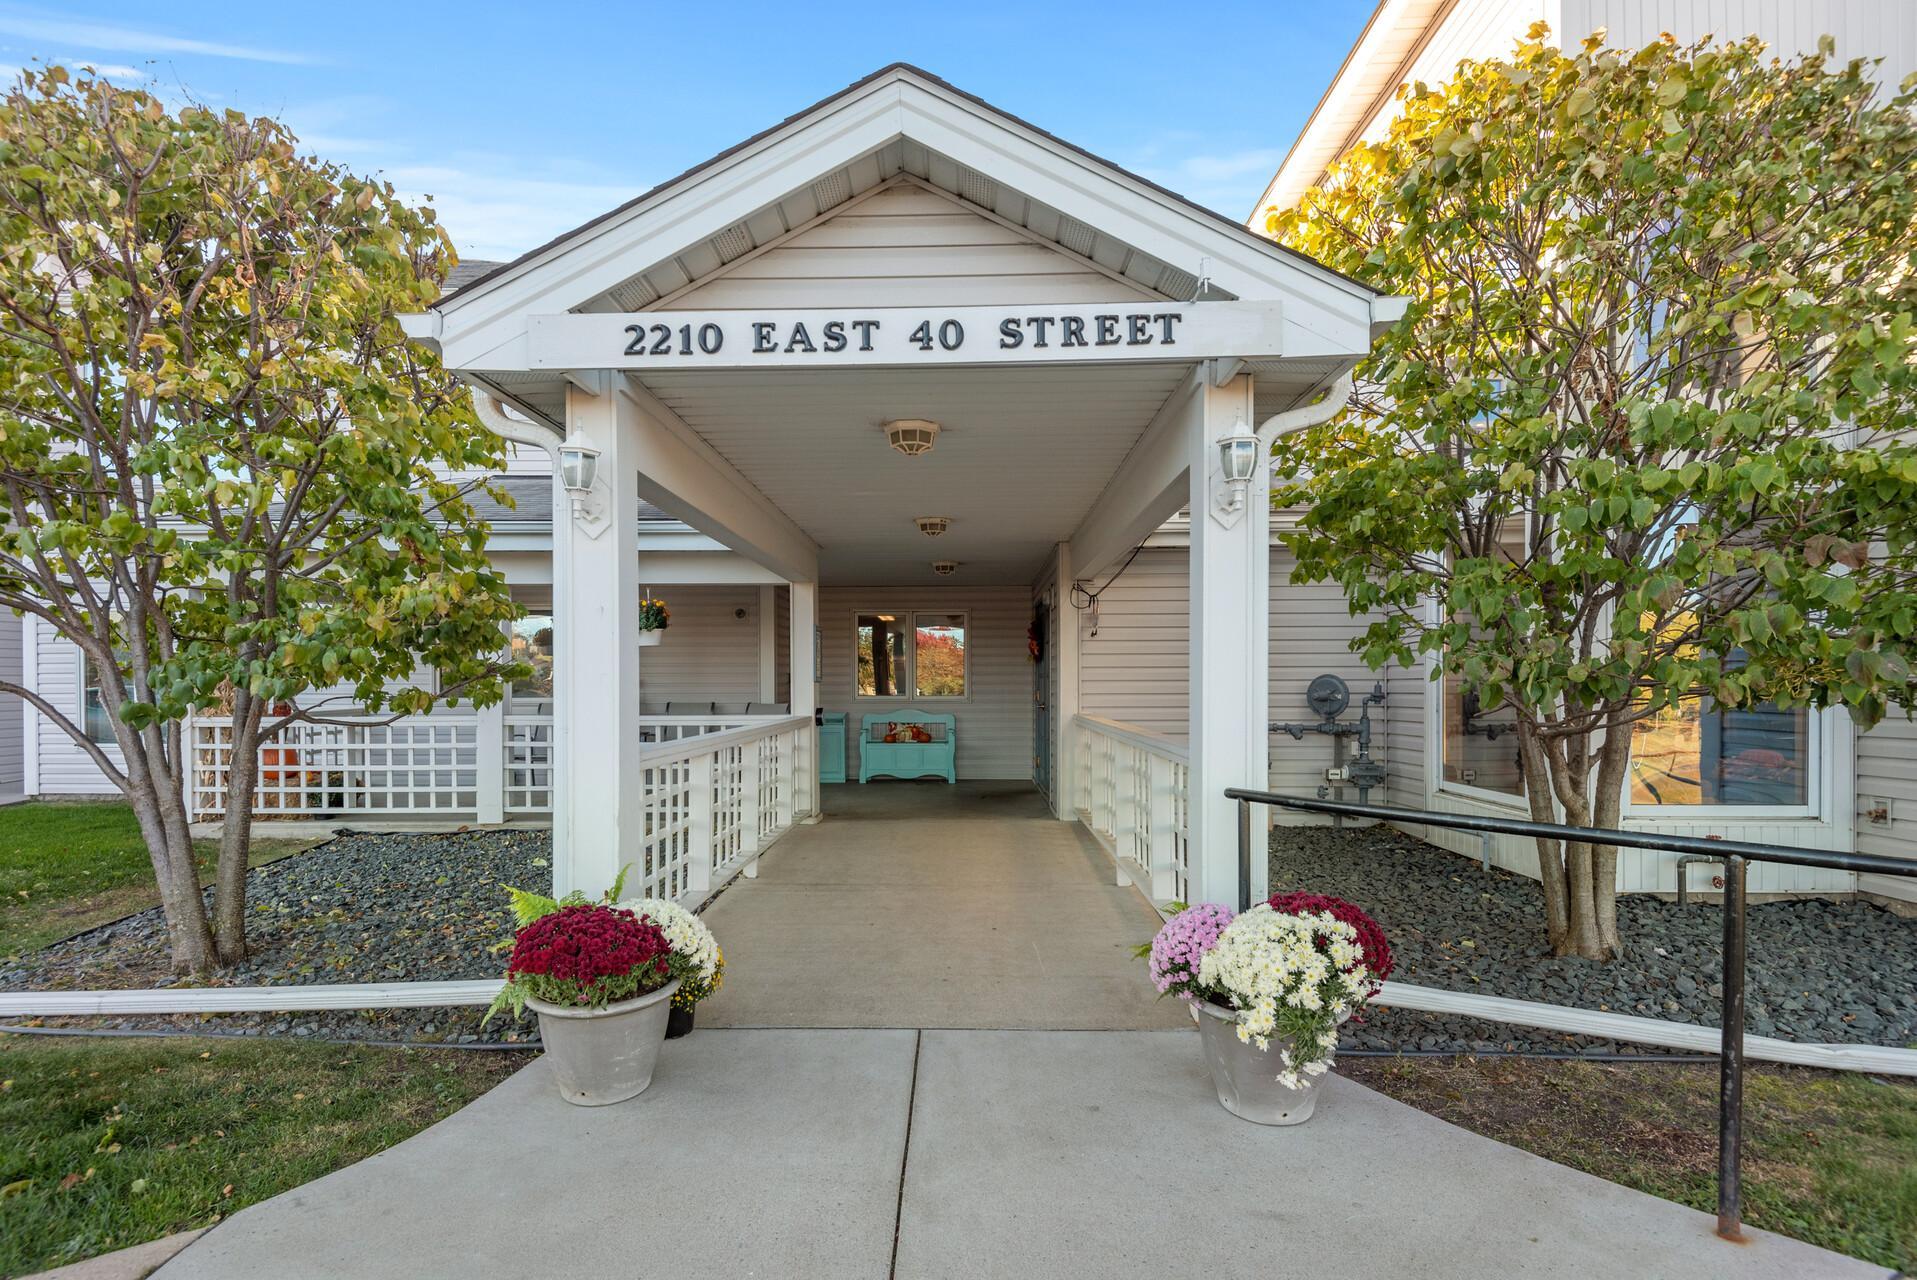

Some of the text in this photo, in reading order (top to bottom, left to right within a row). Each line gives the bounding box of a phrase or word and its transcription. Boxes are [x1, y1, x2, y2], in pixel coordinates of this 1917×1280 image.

[623, 313, 1183, 356] 2210 EAST 40 STREET
